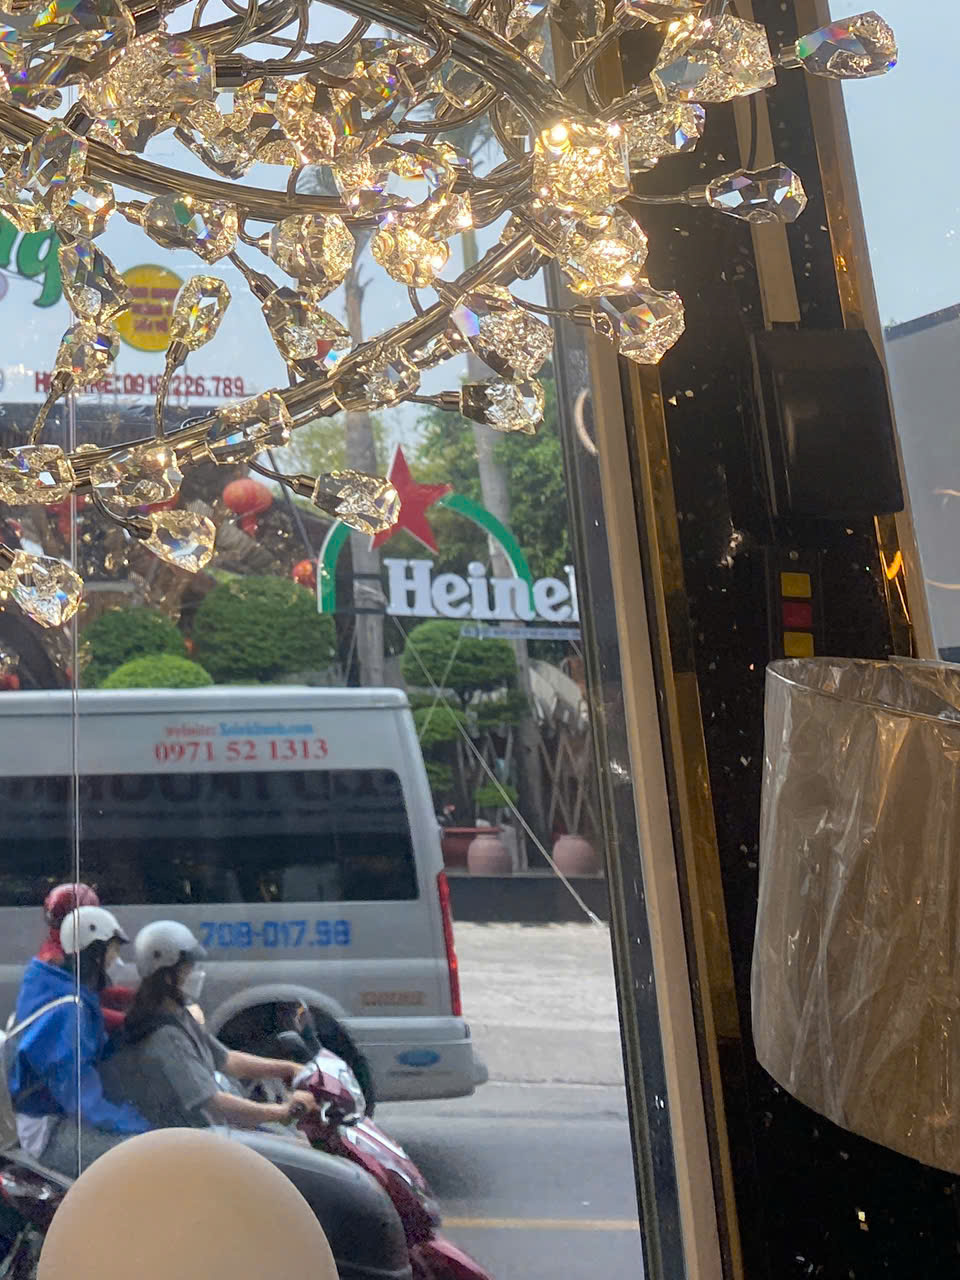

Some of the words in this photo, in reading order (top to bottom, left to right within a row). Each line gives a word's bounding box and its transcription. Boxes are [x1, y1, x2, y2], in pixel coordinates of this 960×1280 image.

[384, 558, 580, 622] Heine
[154, 741, 214, 761] 0971
[226, 740, 258, 761] 52
[270, 738, 329, 760] 1313
